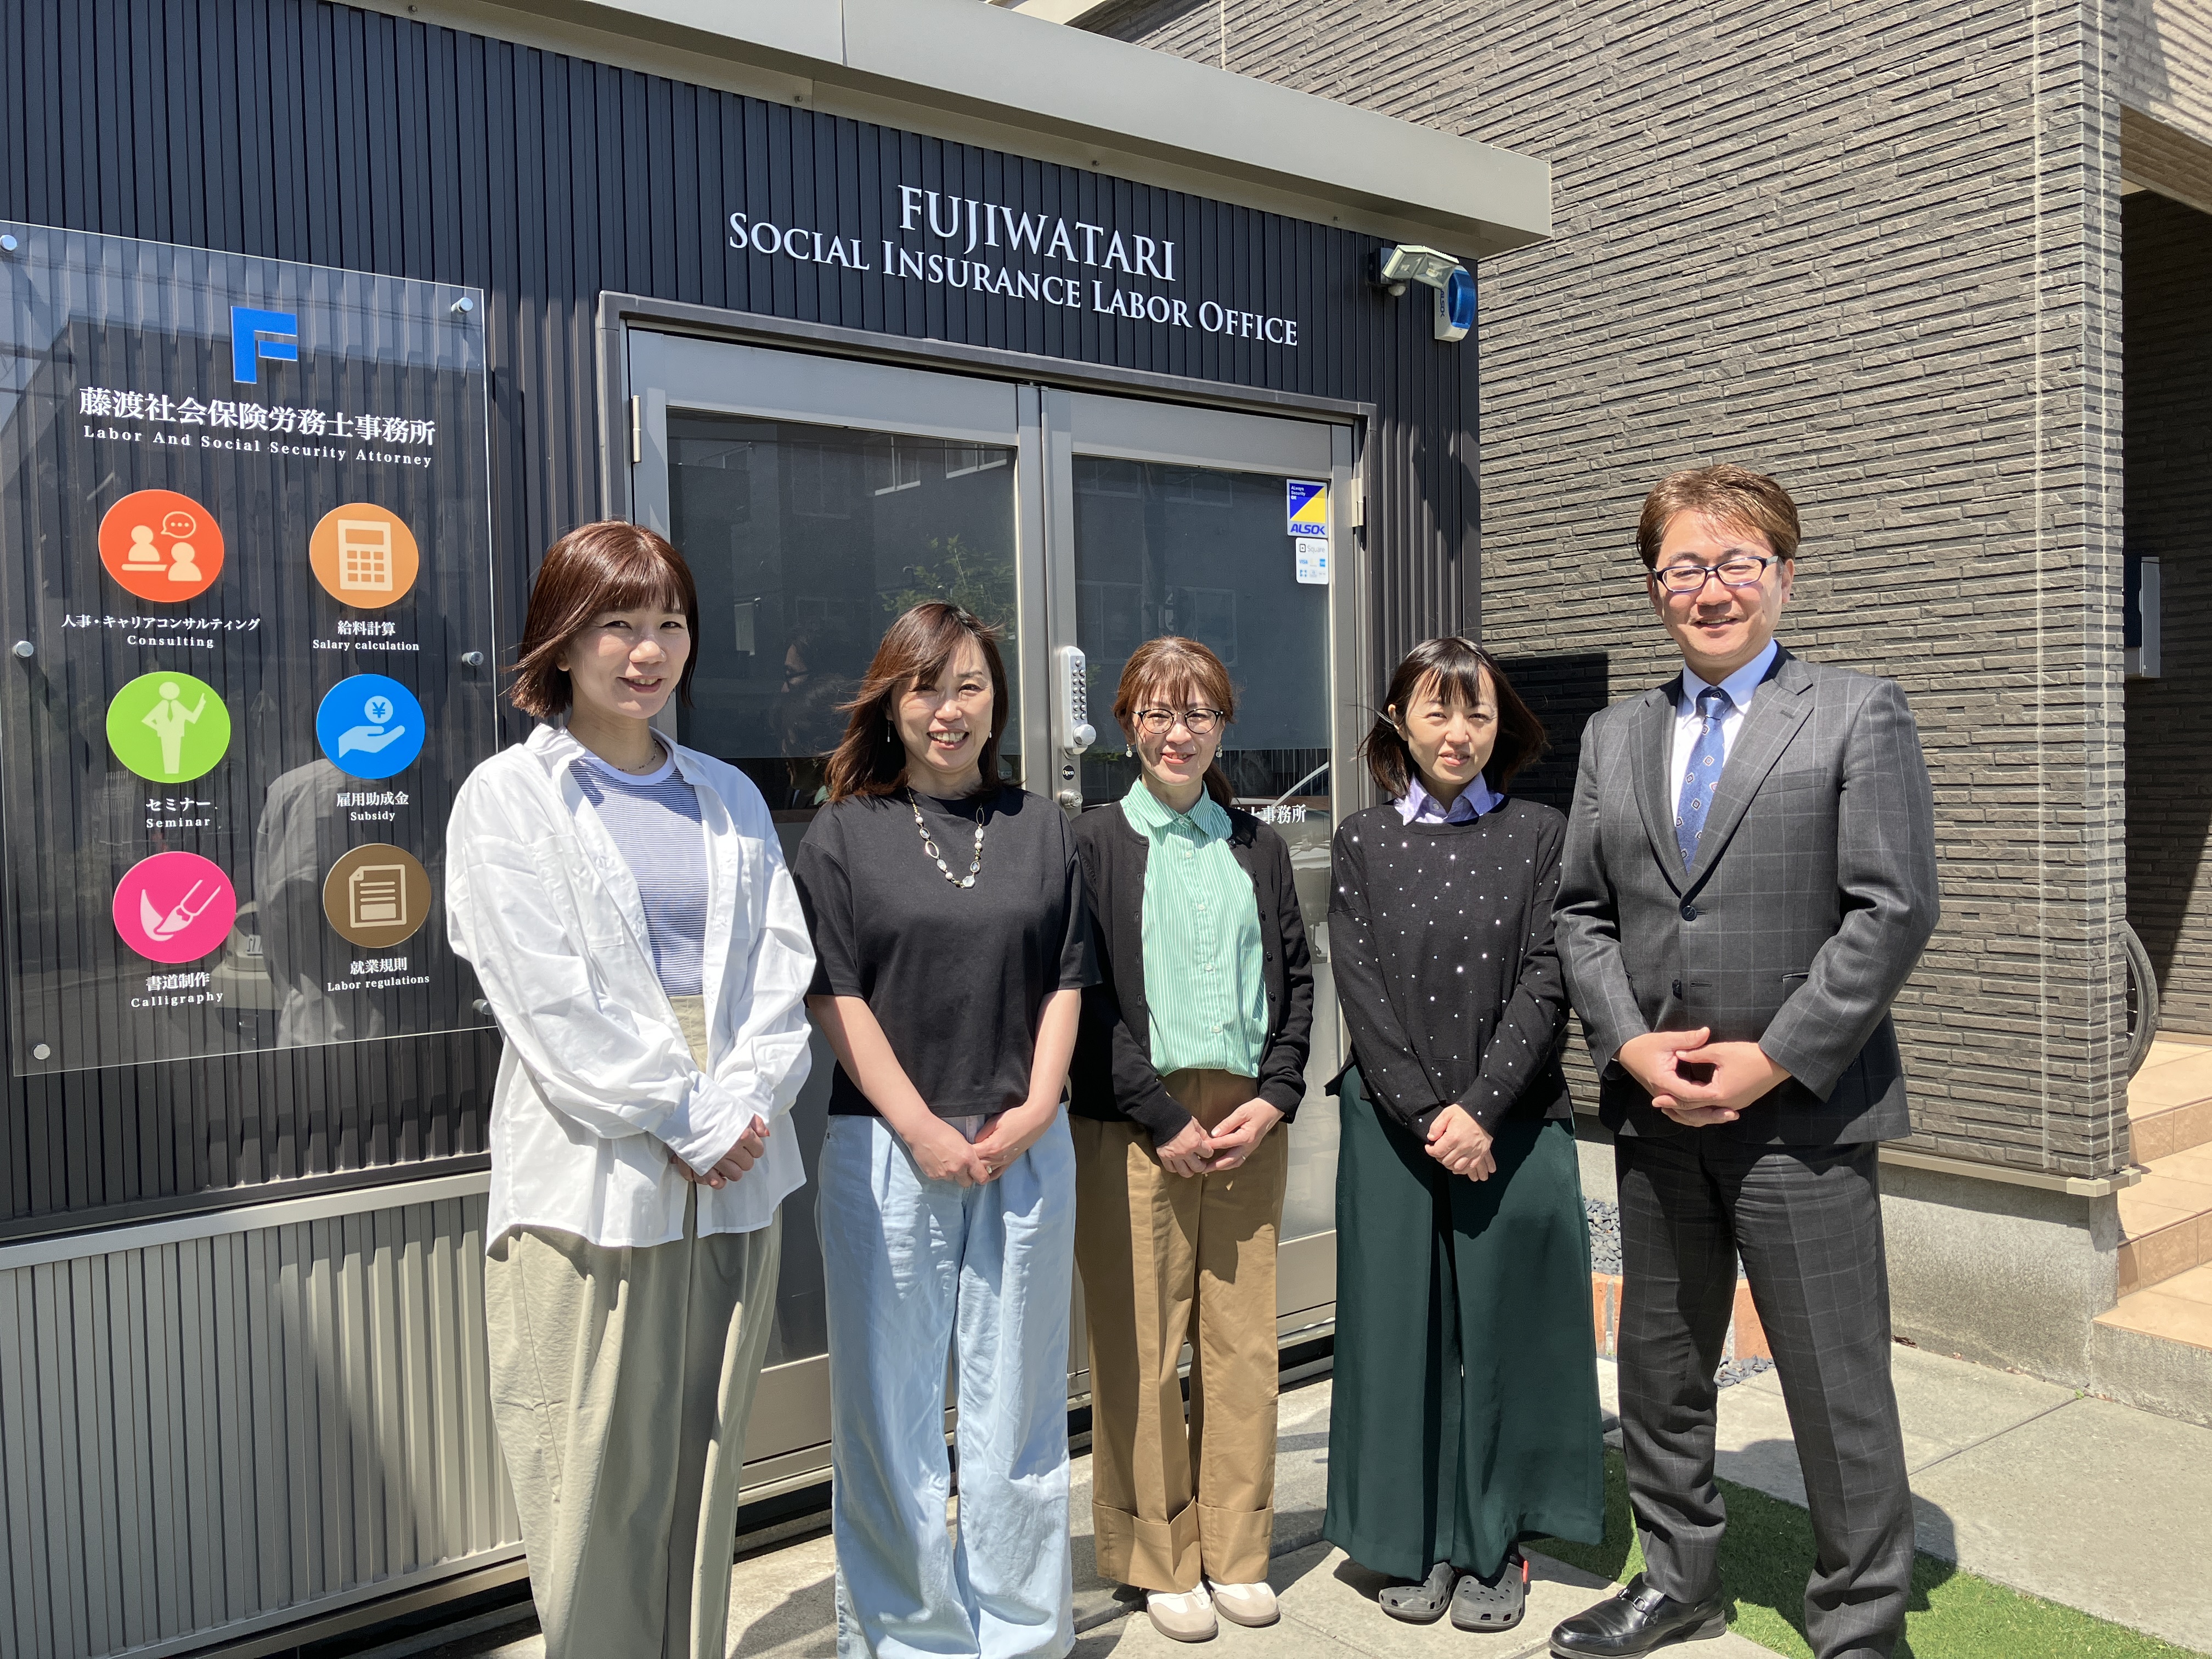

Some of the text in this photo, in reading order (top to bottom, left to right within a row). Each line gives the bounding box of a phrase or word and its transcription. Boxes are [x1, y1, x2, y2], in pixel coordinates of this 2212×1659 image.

[898, 184, 1176, 282] FUJIWATARI
[729, 212, 1299, 346] SOCIAL INSURANCE LABOR OFFICE
[78, 387, 436, 447] 藤渡社会保険労務士事務所
[83, 425, 432, 469] Labor And Social Security Attorney
[1290, 524, 1325, 535] ALSOK
[1307, 545, 1325, 554] Square
[60, 613, 261, 631] 人事・キャリアコンサルティング
[337, 620, 397, 636] 給料計算
[127, 634, 215, 648] Consulting
[312, 639, 420, 652] Salary calculation
[146, 797, 212, 812] セミナー
[336, 791, 410, 808] 雇用助成金
[145, 816, 211, 828] Seminar
[350, 809, 396, 822] Subsidy
[1234, 804, 1307, 825] 事務所
[349, 957, 408, 975] 就業規則
[145, 971, 211, 993] 書道制作
[327, 973, 430, 992] Labor regulations
[131, 990, 224, 1009] Calligraphy
